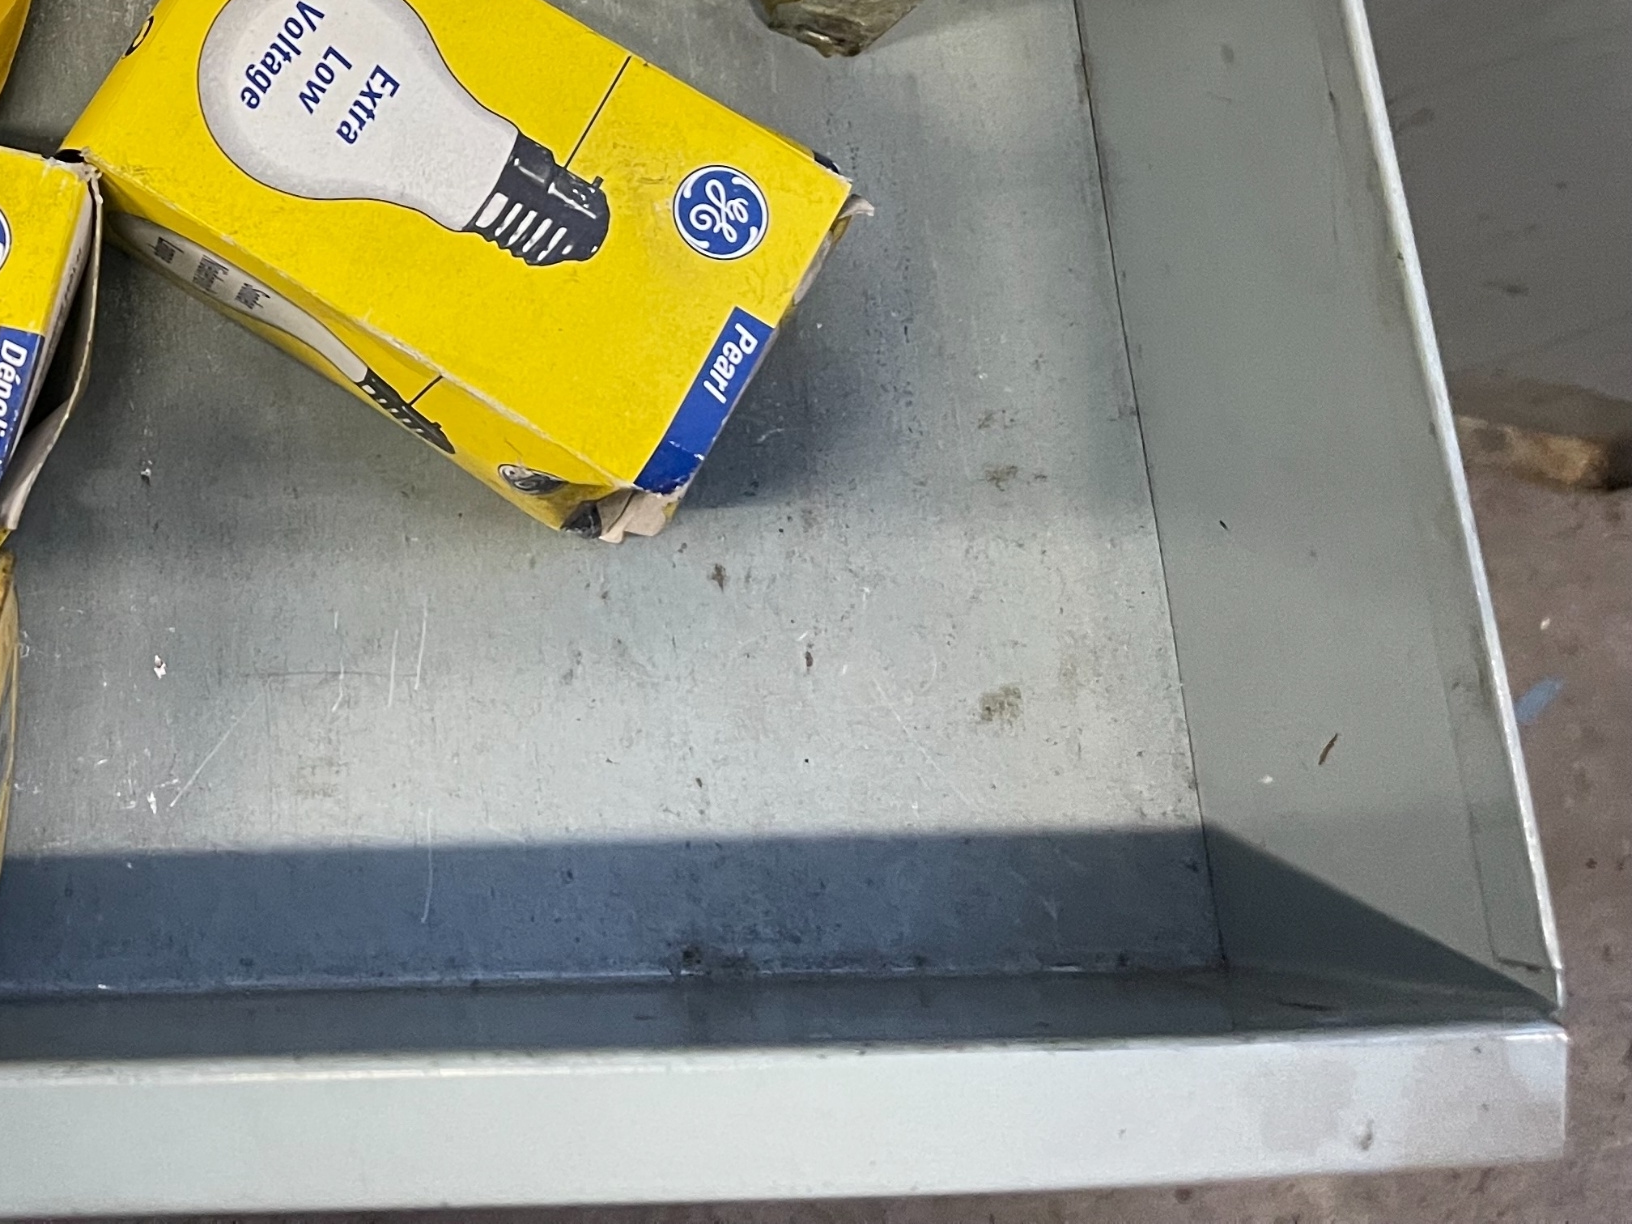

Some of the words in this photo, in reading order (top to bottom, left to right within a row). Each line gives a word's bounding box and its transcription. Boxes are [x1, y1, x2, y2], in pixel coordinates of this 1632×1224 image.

[240, 0, 325, 110] Voltage
[298, 45, 353, 115] Low
[336, 64, 400, 145] Extra
[703, 322, 758, 405] Pearl
